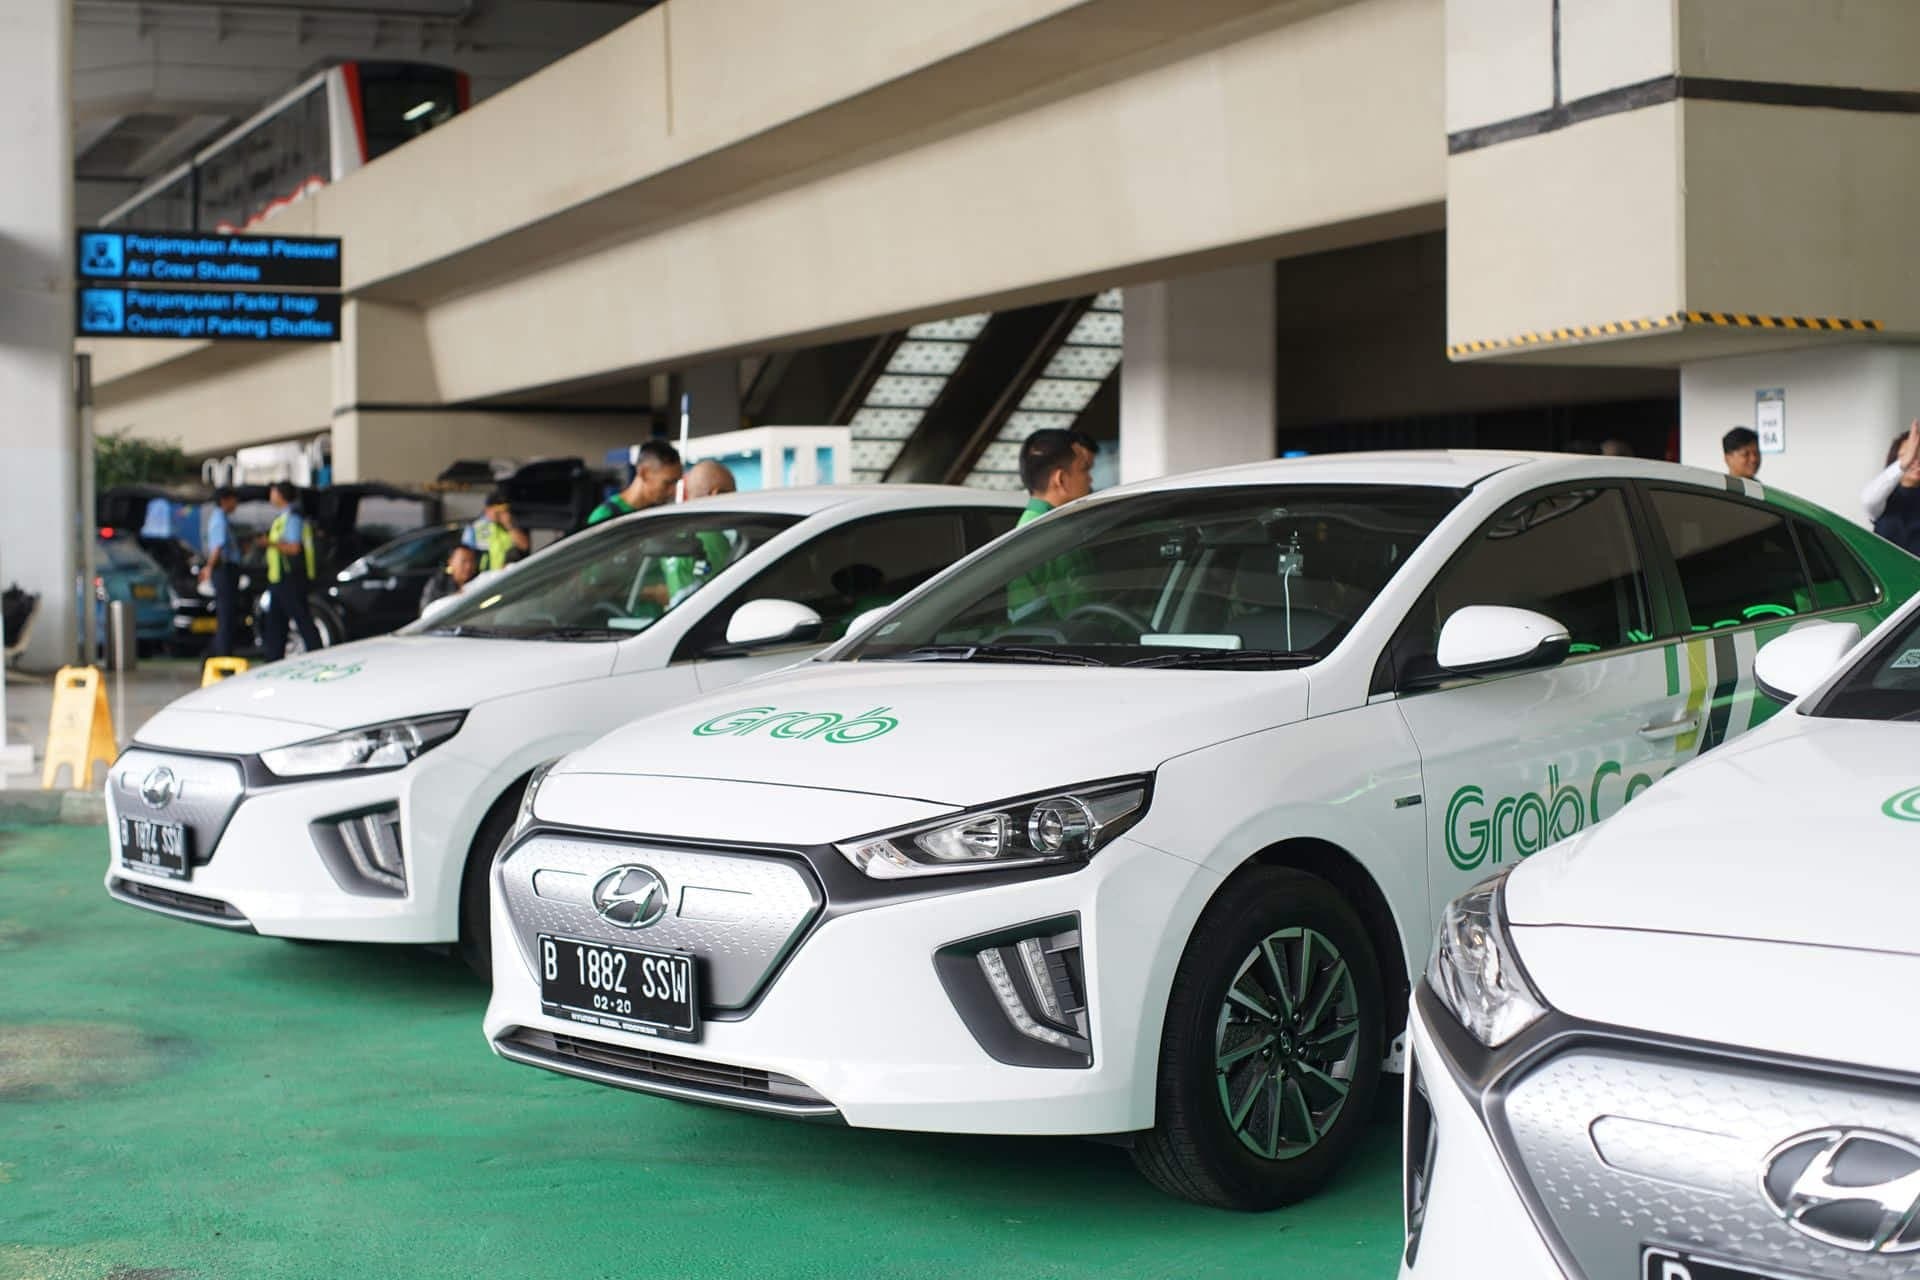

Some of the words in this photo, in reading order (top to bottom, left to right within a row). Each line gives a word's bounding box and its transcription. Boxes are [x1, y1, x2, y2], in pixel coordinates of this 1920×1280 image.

[228, 240, 270, 257] Awak
[127, 260, 149, 277] Air
[152, 260, 194, 278] Crew
[196, 261, 260, 281] Shuttles
[127, 314, 205, 336] Overnight
[207, 317, 268, 338] Parking
[270, 318, 332, 336] Shuttles
[692, 706, 898, 744] Grab
[1444, 760, 1678, 872] GrabC
[544, 940, 558, 981] B
[576, 945, 627, 994] 1882
[641, 957, 686, 1004] SSW
